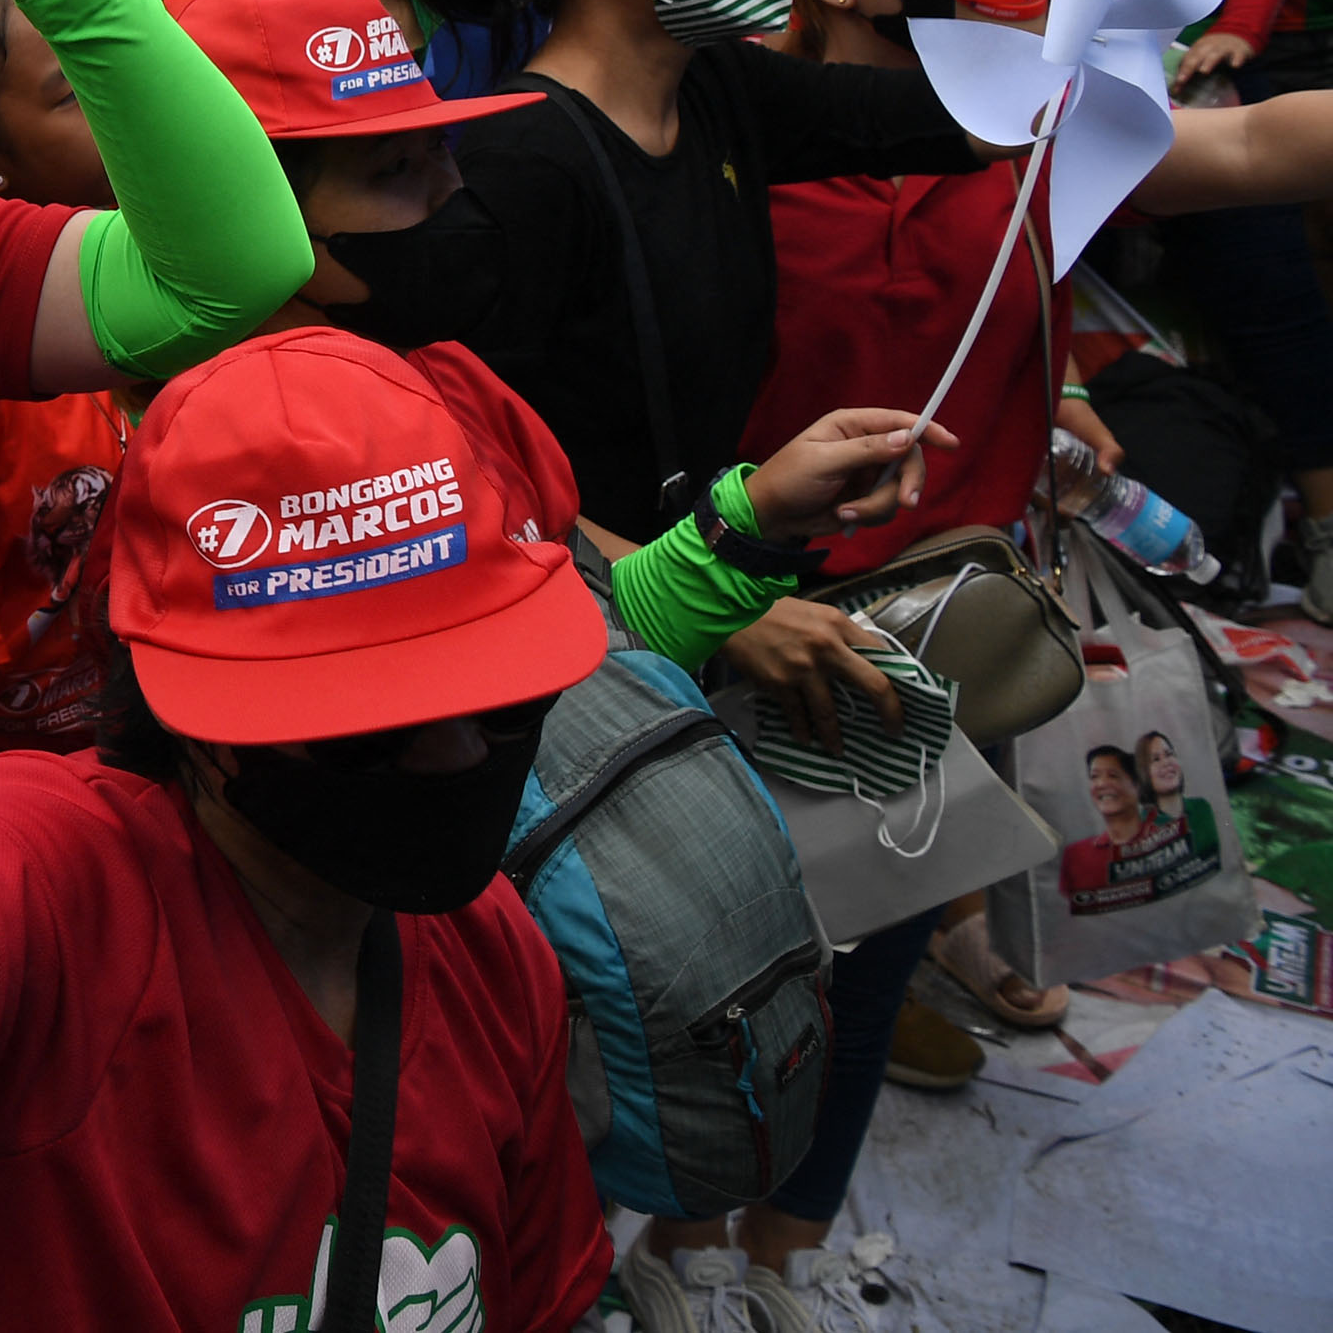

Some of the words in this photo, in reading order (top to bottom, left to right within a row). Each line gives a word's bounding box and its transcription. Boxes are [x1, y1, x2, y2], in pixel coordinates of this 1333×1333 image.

[316, 28, 353, 65] #7
[339, 77, 364, 92] FOR
[197, 505, 258, 558] #7
[280, 457, 455, 519] BONGBONG
[278, 482, 464, 554] MARCOS
[227, 579, 260, 598] FOR
